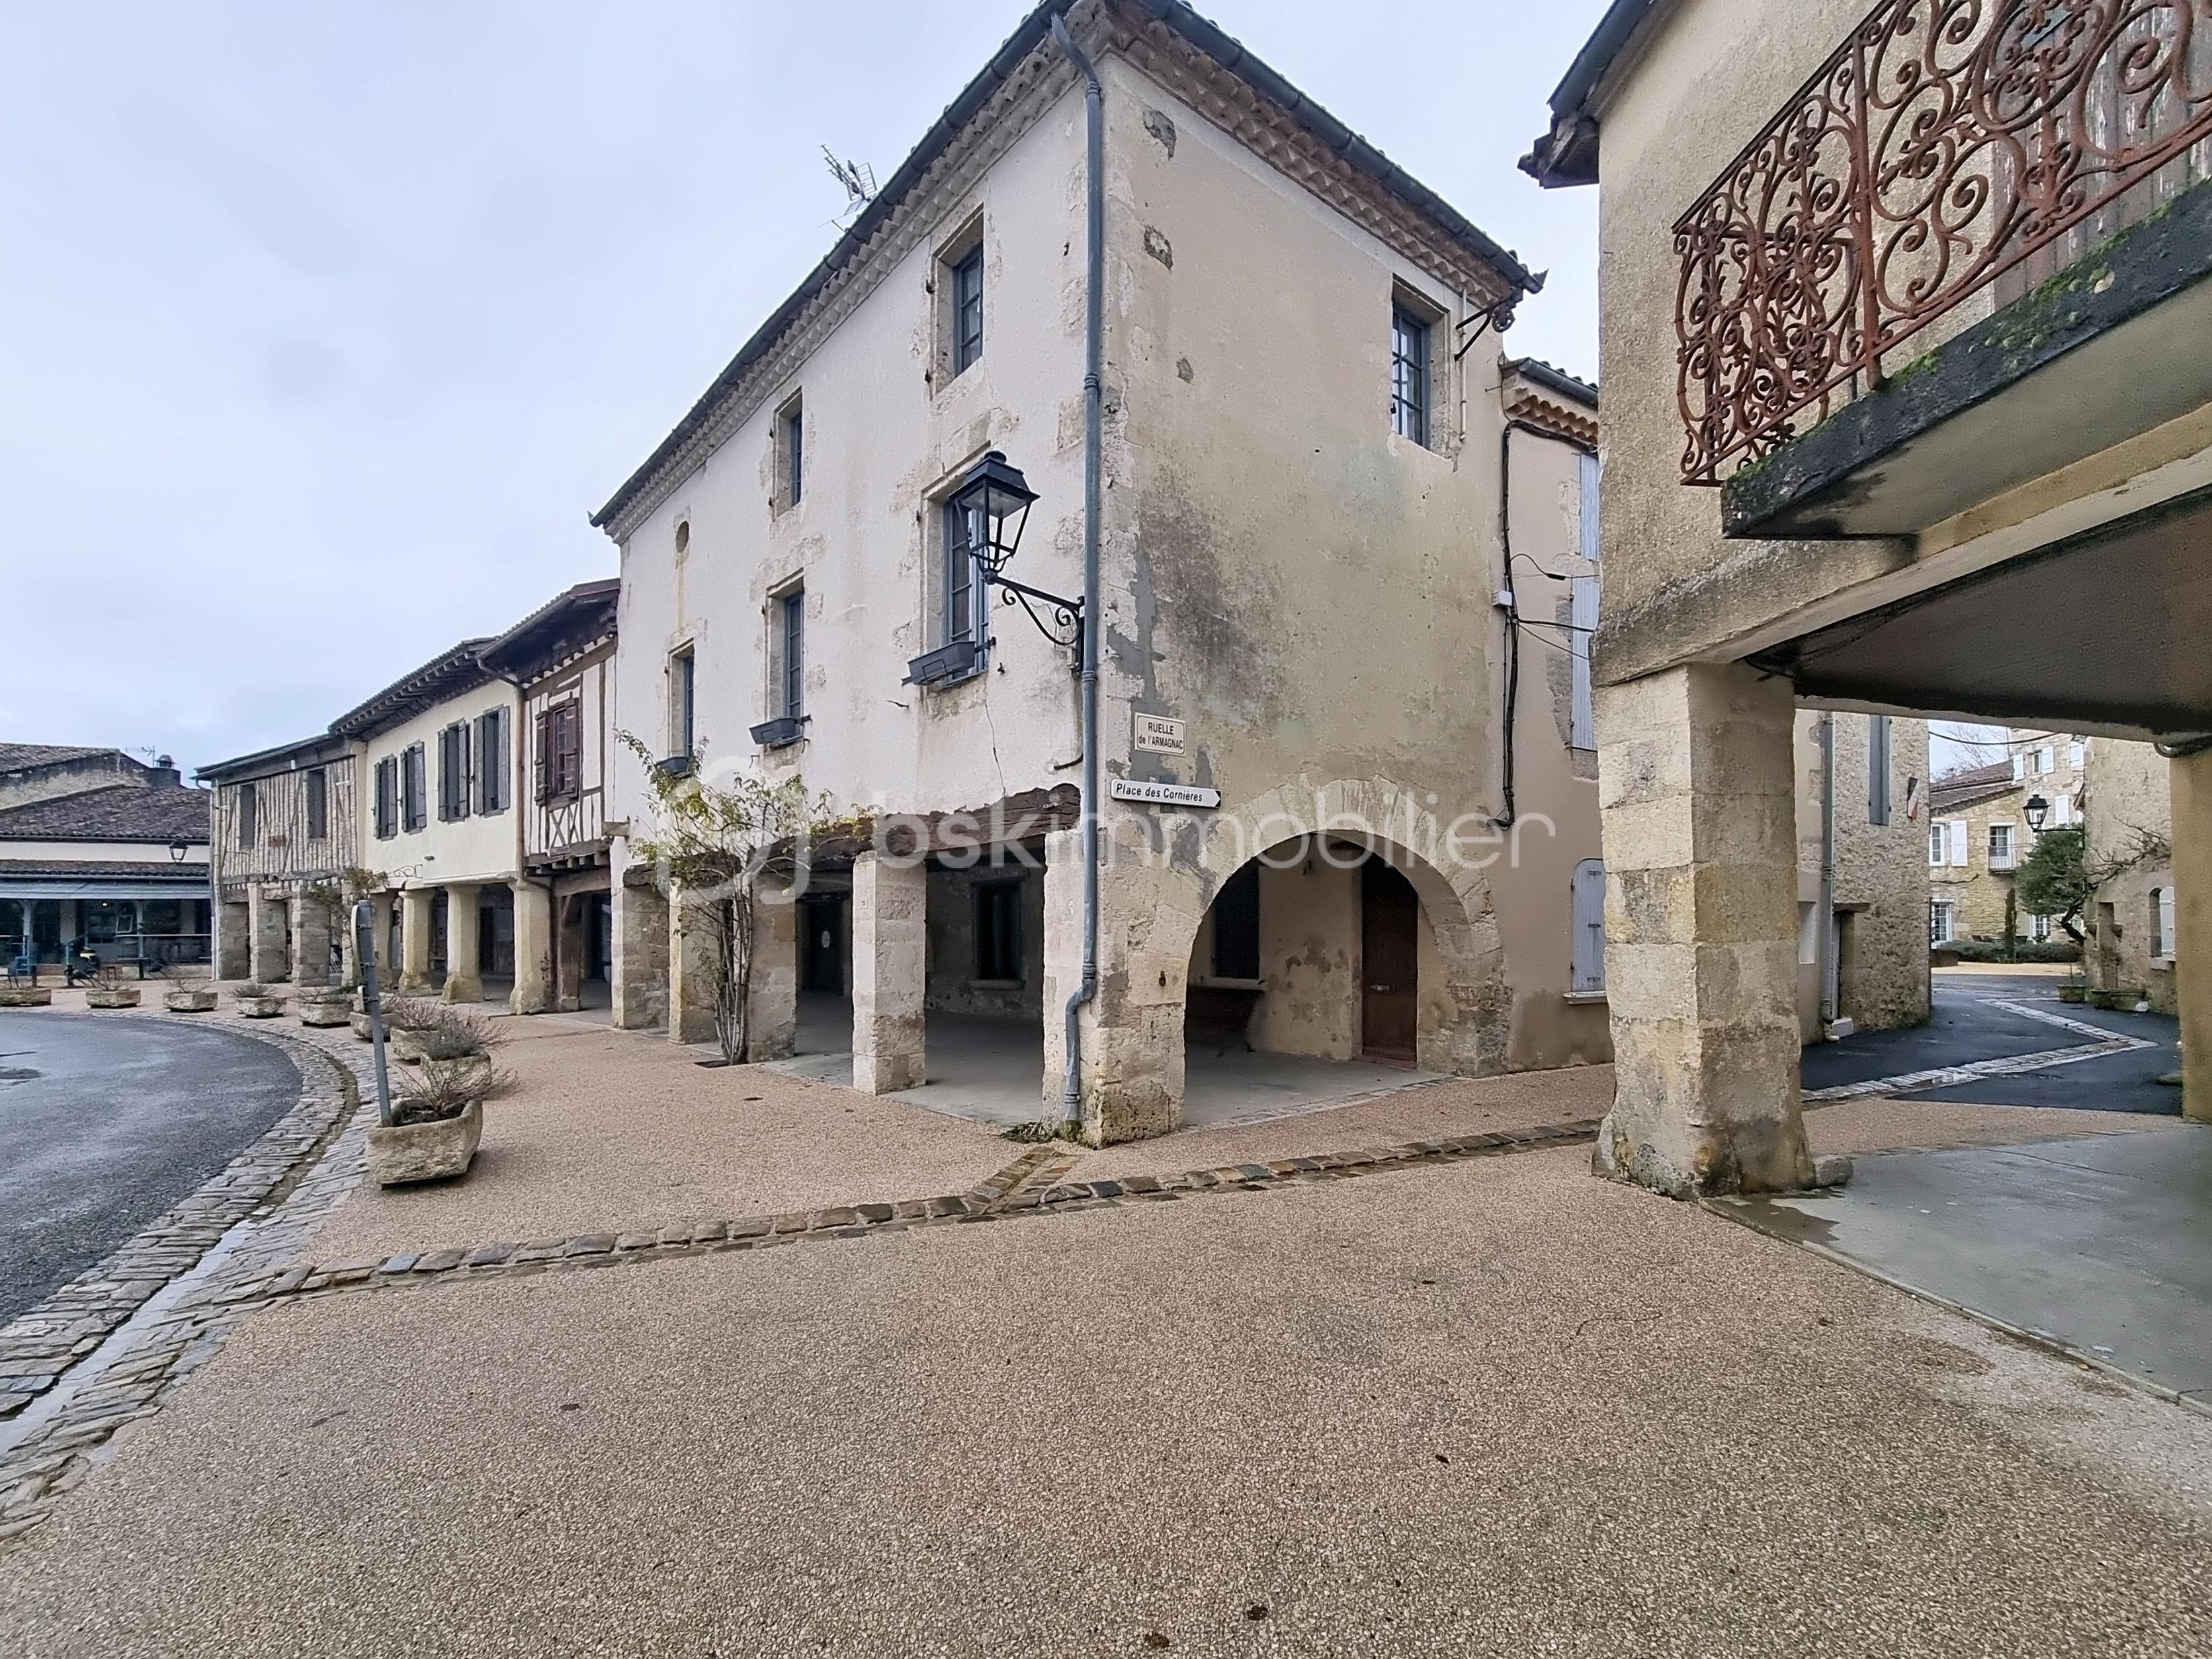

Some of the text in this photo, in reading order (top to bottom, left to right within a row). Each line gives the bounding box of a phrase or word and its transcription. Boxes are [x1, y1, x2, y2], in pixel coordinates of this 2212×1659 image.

[1148, 722, 1174, 735] RUELLE
[1138, 734, 1183, 749] de l'ARMAGNAC
[1116, 783, 1203, 802] Place des Cornières
